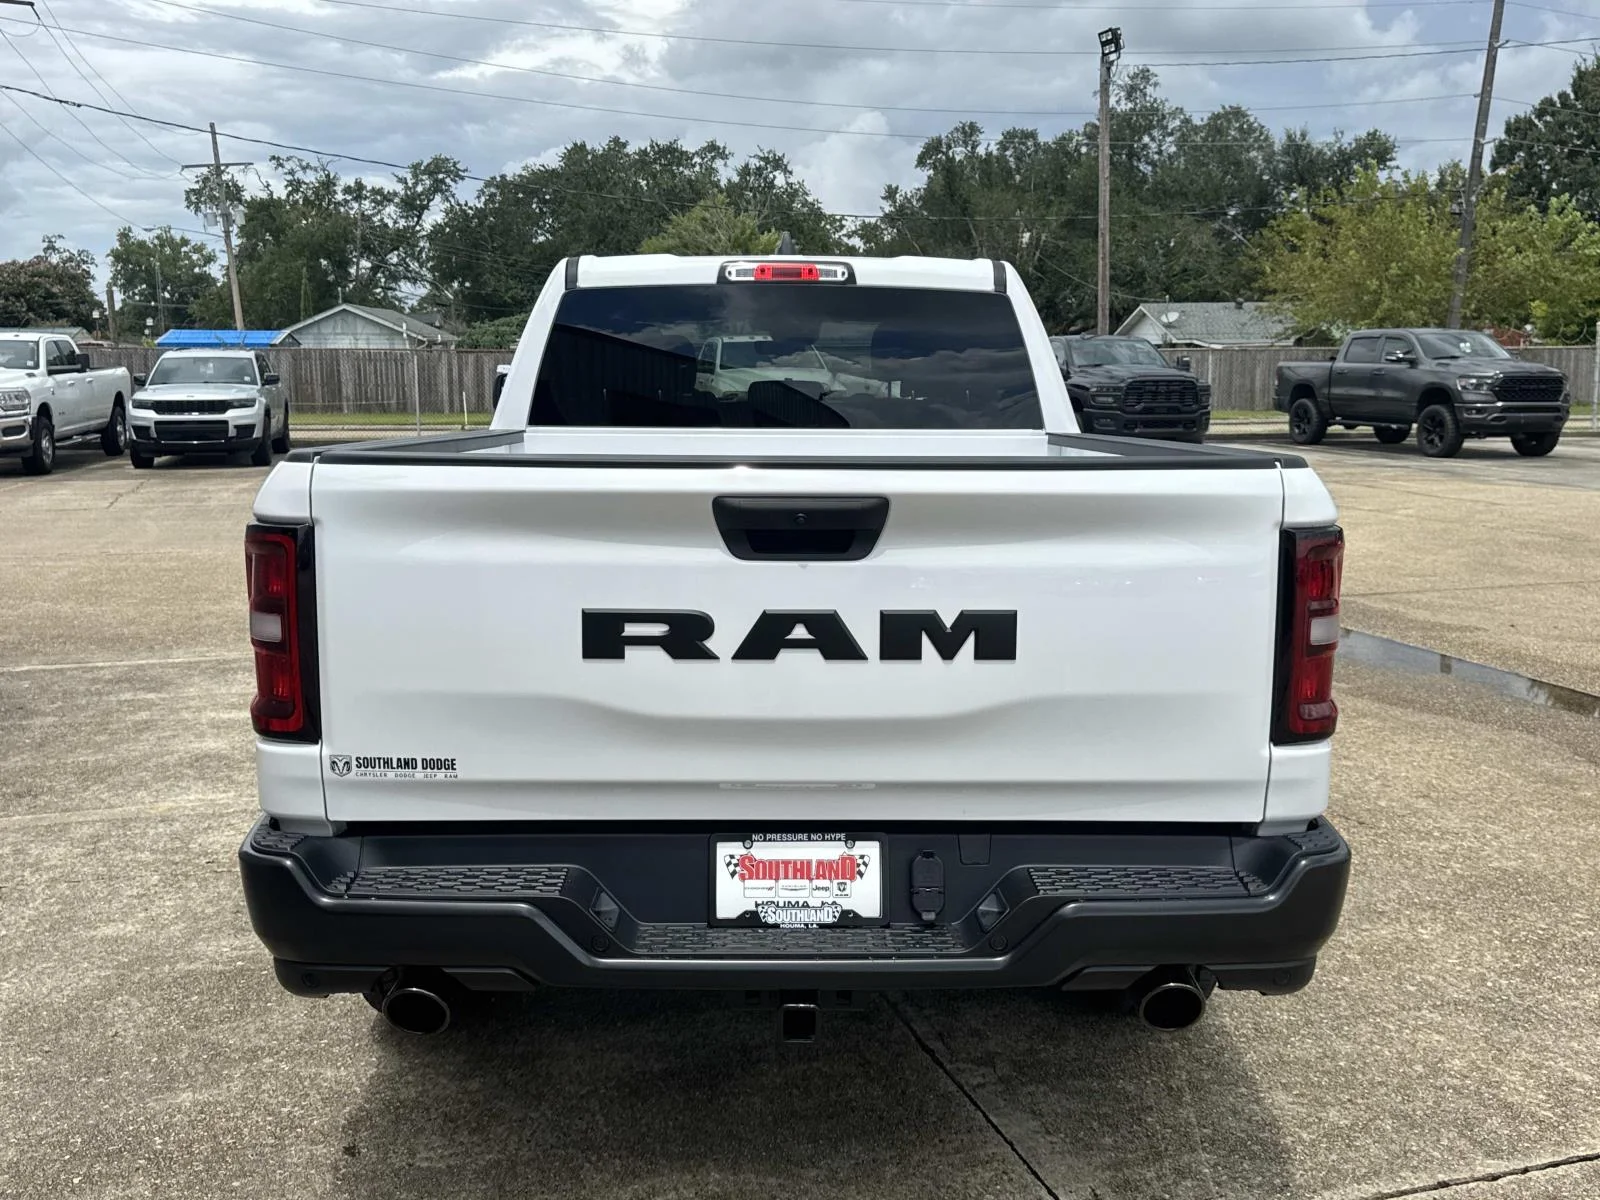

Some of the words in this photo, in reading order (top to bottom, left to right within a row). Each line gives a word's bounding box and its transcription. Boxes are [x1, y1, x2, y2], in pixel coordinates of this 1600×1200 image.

[581, 607, 1018, 661] RAM
[355, 756, 418, 770] SOUTHLAND
[421, 758, 457, 771] DODGE
[752, 833, 764, 841] NO
[766, 833, 809, 841] PRESSURE
[810, 833, 823, 841] NO
[824, 833, 846, 841] HYPE
[812, 884, 830, 892] Jeep
